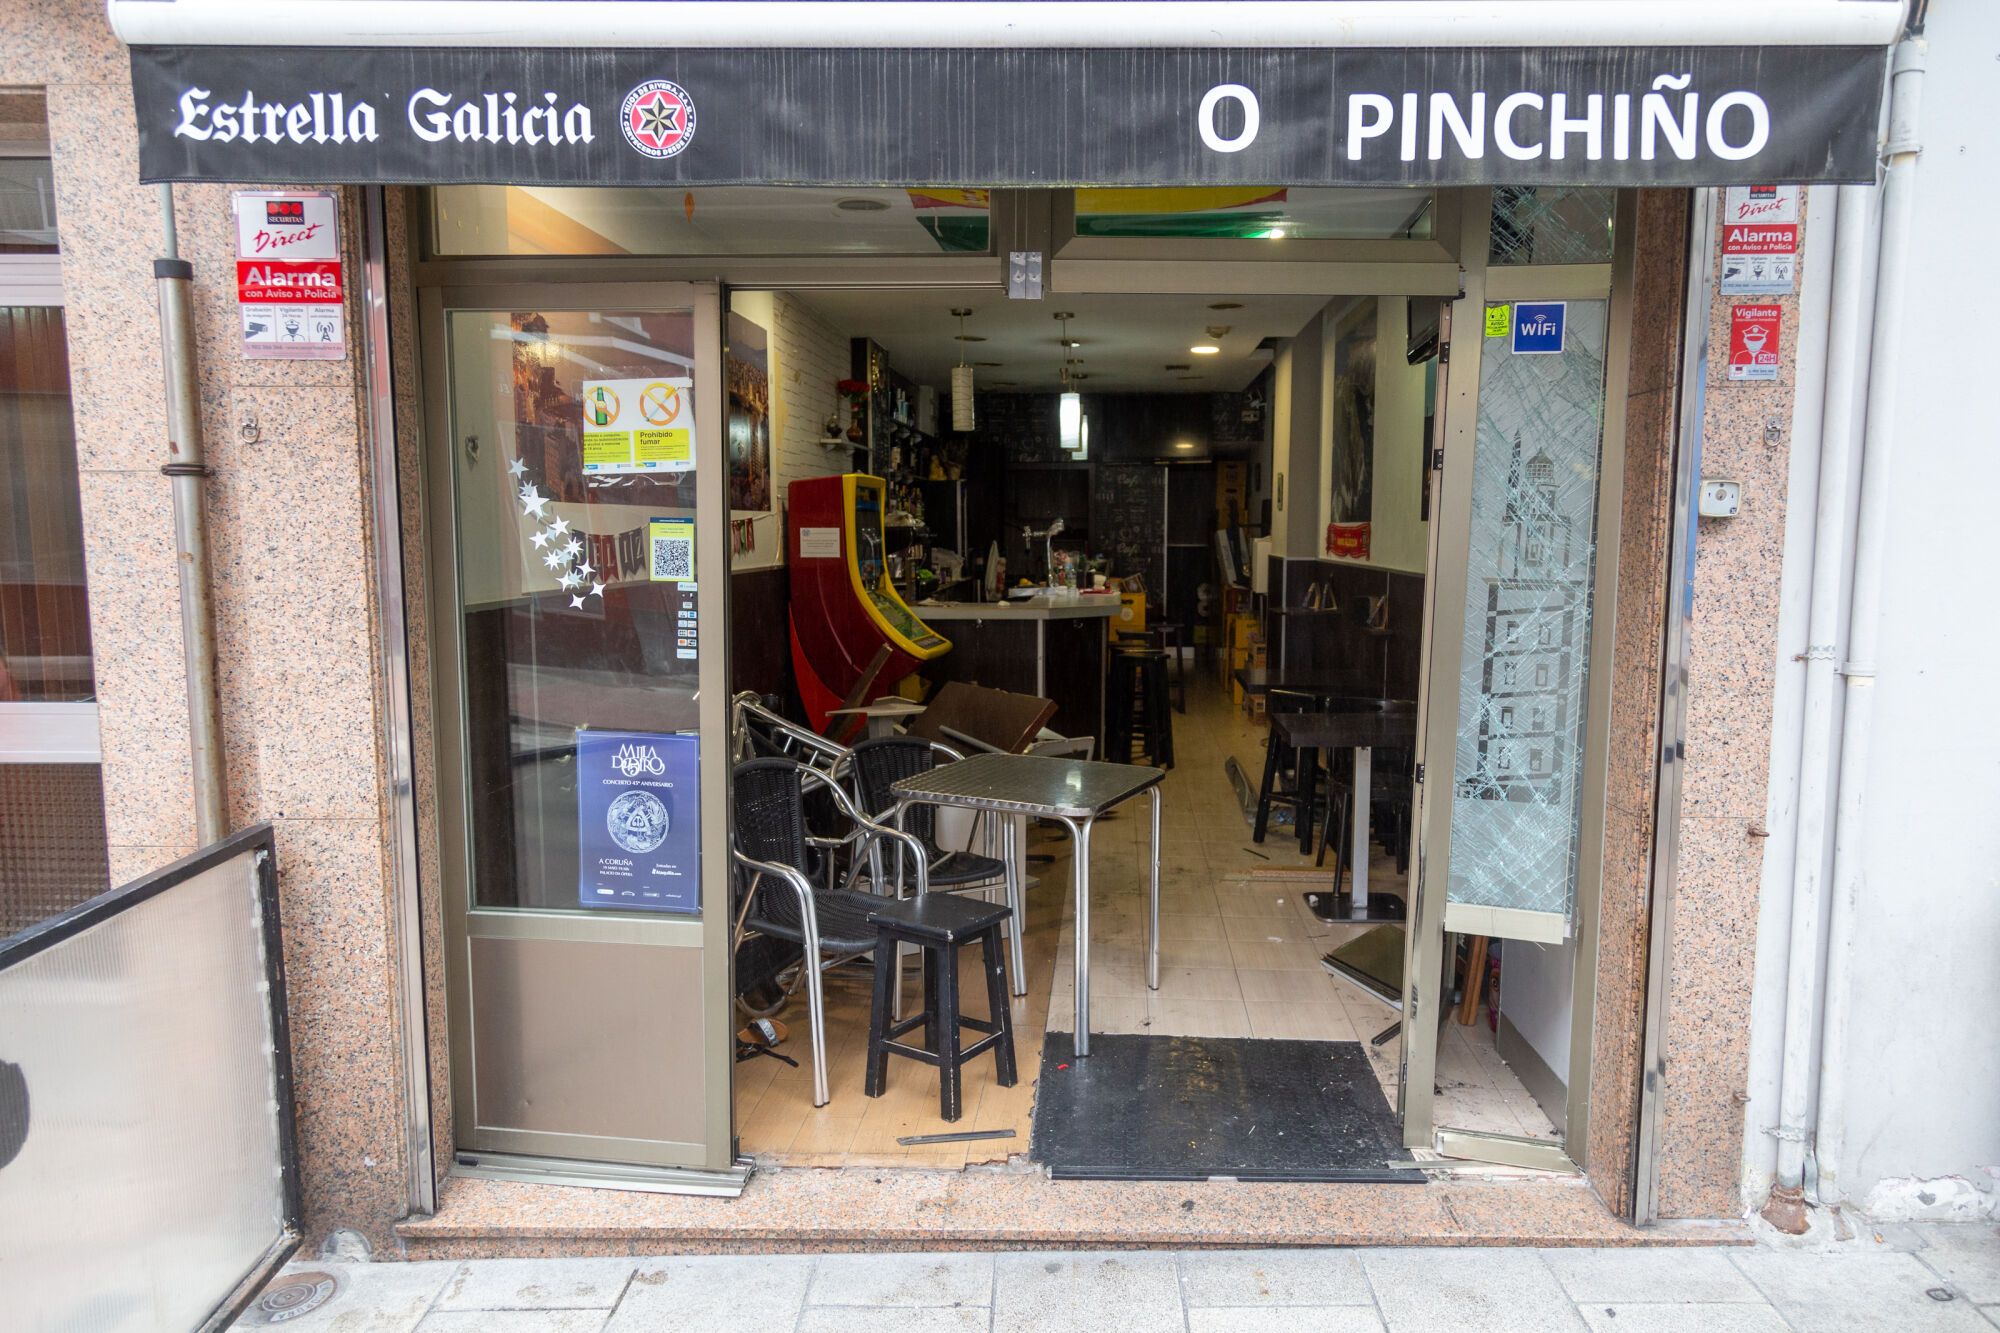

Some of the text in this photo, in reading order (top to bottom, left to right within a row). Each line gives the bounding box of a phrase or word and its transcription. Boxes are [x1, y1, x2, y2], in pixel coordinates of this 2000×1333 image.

[623, 93, 639, 114] HIJOS
[637, 85, 649, 95] DE
[174, 87, 595, 146] Estrella Galicia
[1198, 73, 1770, 162] O PINCHIÑO
[623, 121, 662, 156] CERVECEROS
[662, 139, 686, 155] DESDE
[1738, 197, 1788, 219] Direct
[253, 223, 324, 253] Direct
[1728, 228, 1793, 242] Alarma
[245, 265, 336, 287] Alarma
[245, 290, 263, 298] con
[265, 289, 293, 298] Aviso
[304, 289, 337, 298] Policía
[1736, 308, 1777, 318] Vigilante
[1759, 354, 1776, 362] 24H
[604, 858, 633, 866] CORUÑA
